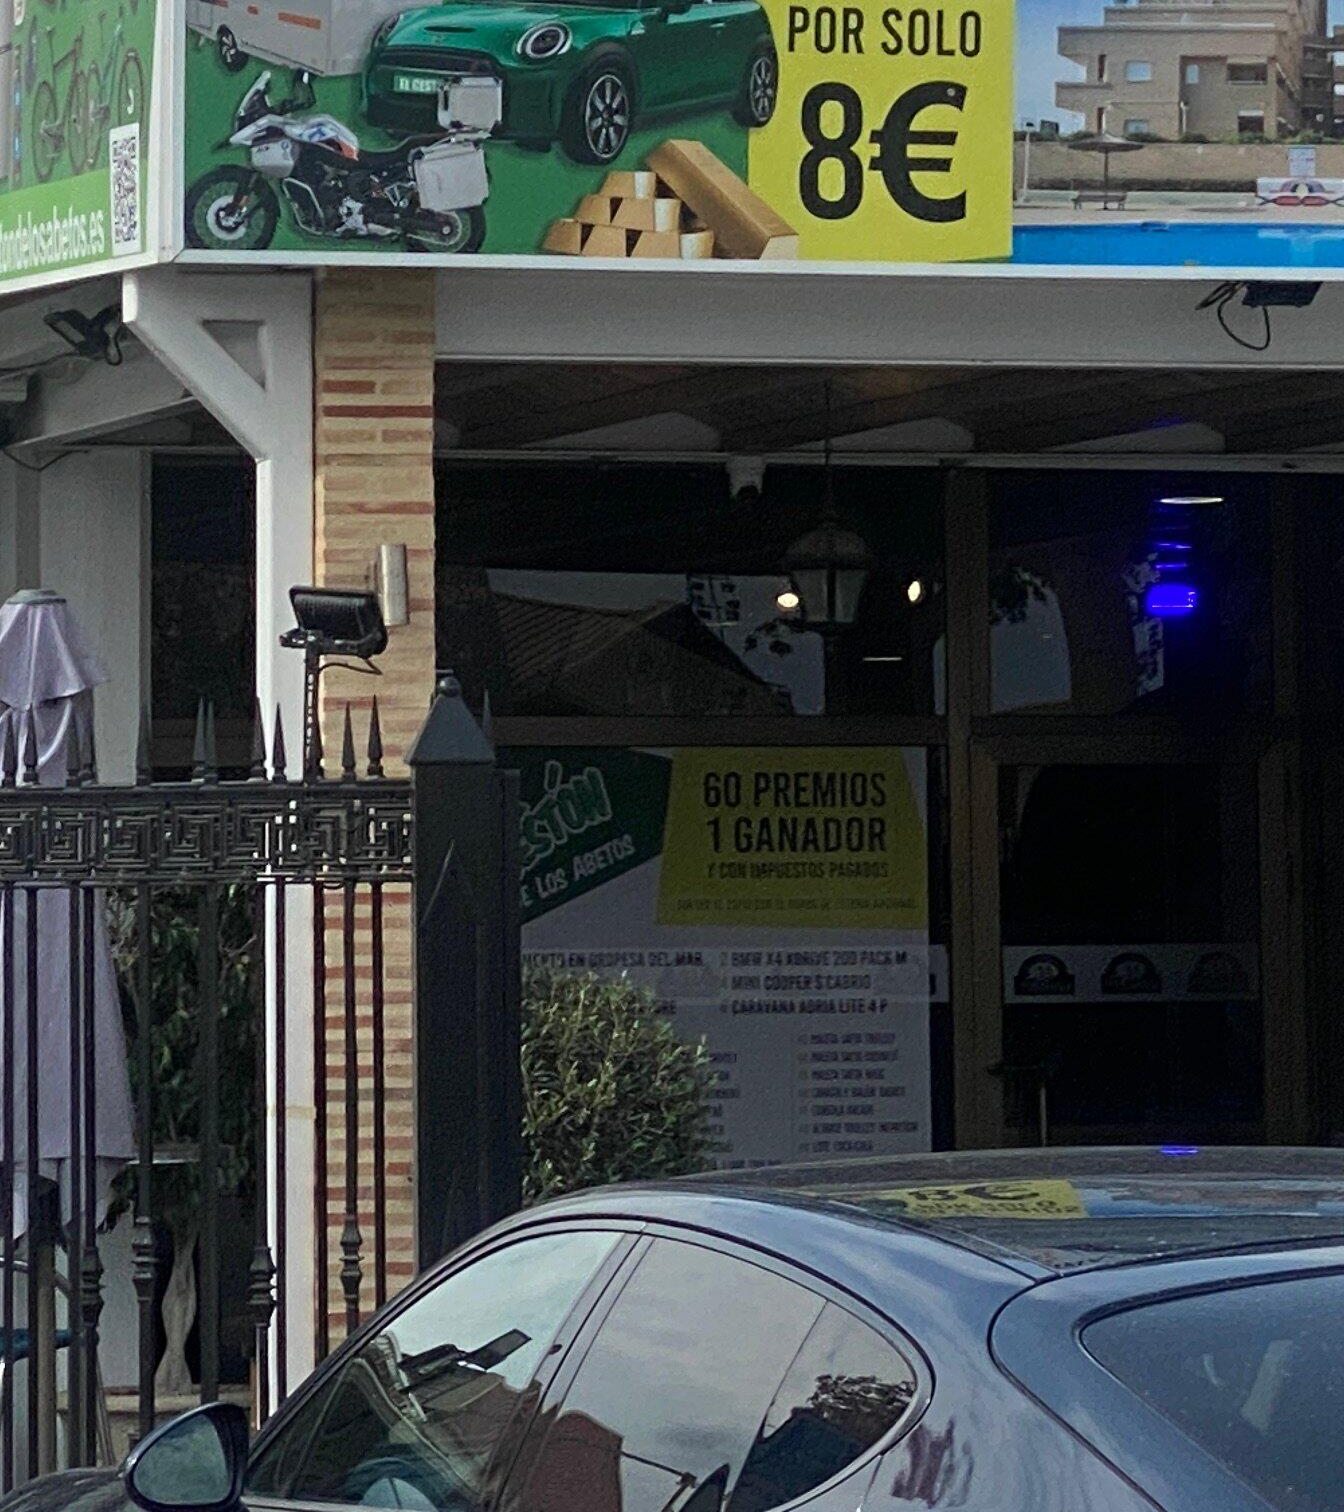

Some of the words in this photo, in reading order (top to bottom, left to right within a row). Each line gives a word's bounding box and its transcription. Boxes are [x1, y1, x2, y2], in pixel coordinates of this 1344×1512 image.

[788, 6, 865, 55] POR
[881, 7, 982, 57] SOLO
[799, 81, 968, 224] 8€
[702, 771, 742, 809] 60
[753, 771, 887, 809] PREMIOS
[706, 817, 721, 854] 1
[733, 816, 888, 854] GANADOR
[535, 868, 568, 898] LOS
[573, 834, 636, 881] ABETOS
